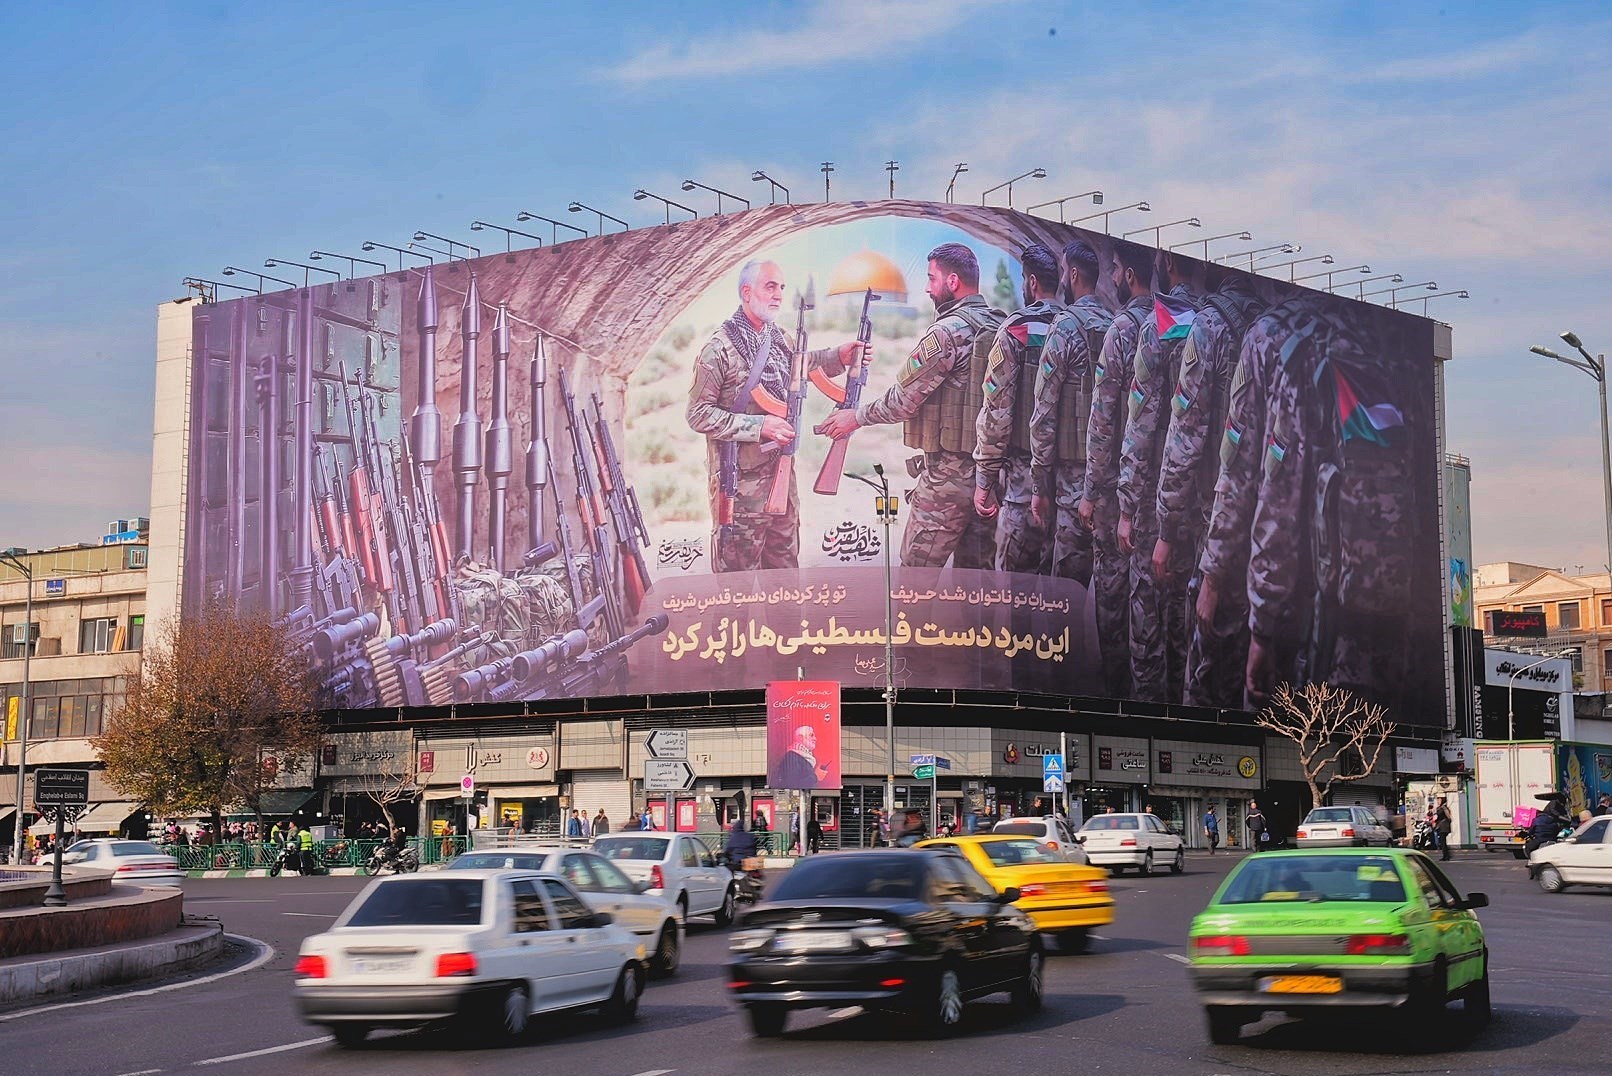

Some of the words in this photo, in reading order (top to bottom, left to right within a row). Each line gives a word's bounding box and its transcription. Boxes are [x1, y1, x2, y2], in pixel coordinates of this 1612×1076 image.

[662, 592, 697, 613] شریف
[814, 584, 831, 607] پُر
[833, 584, 847, 604] تو
[890, 585, 937, 604] حریف
[939, 585, 967, 601] شد
[968, 587, 1012, 606] ناتوان
[1014, 592, 1027, 608] تو
[662, 621, 702, 661] کرد
[699, 617, 729, 665] پُر
[731, 619, 747, 657] را
[749, 611, 912, 655] فسطینی‌ها
[914, 622, 992, 648] دست
[995, 626, 1034, 658] مرد
[1036, 625, 1069, 662] این
[1474, 685, 1484, 739] SAMSUNG
[78, 792, 85, 800] Sq
